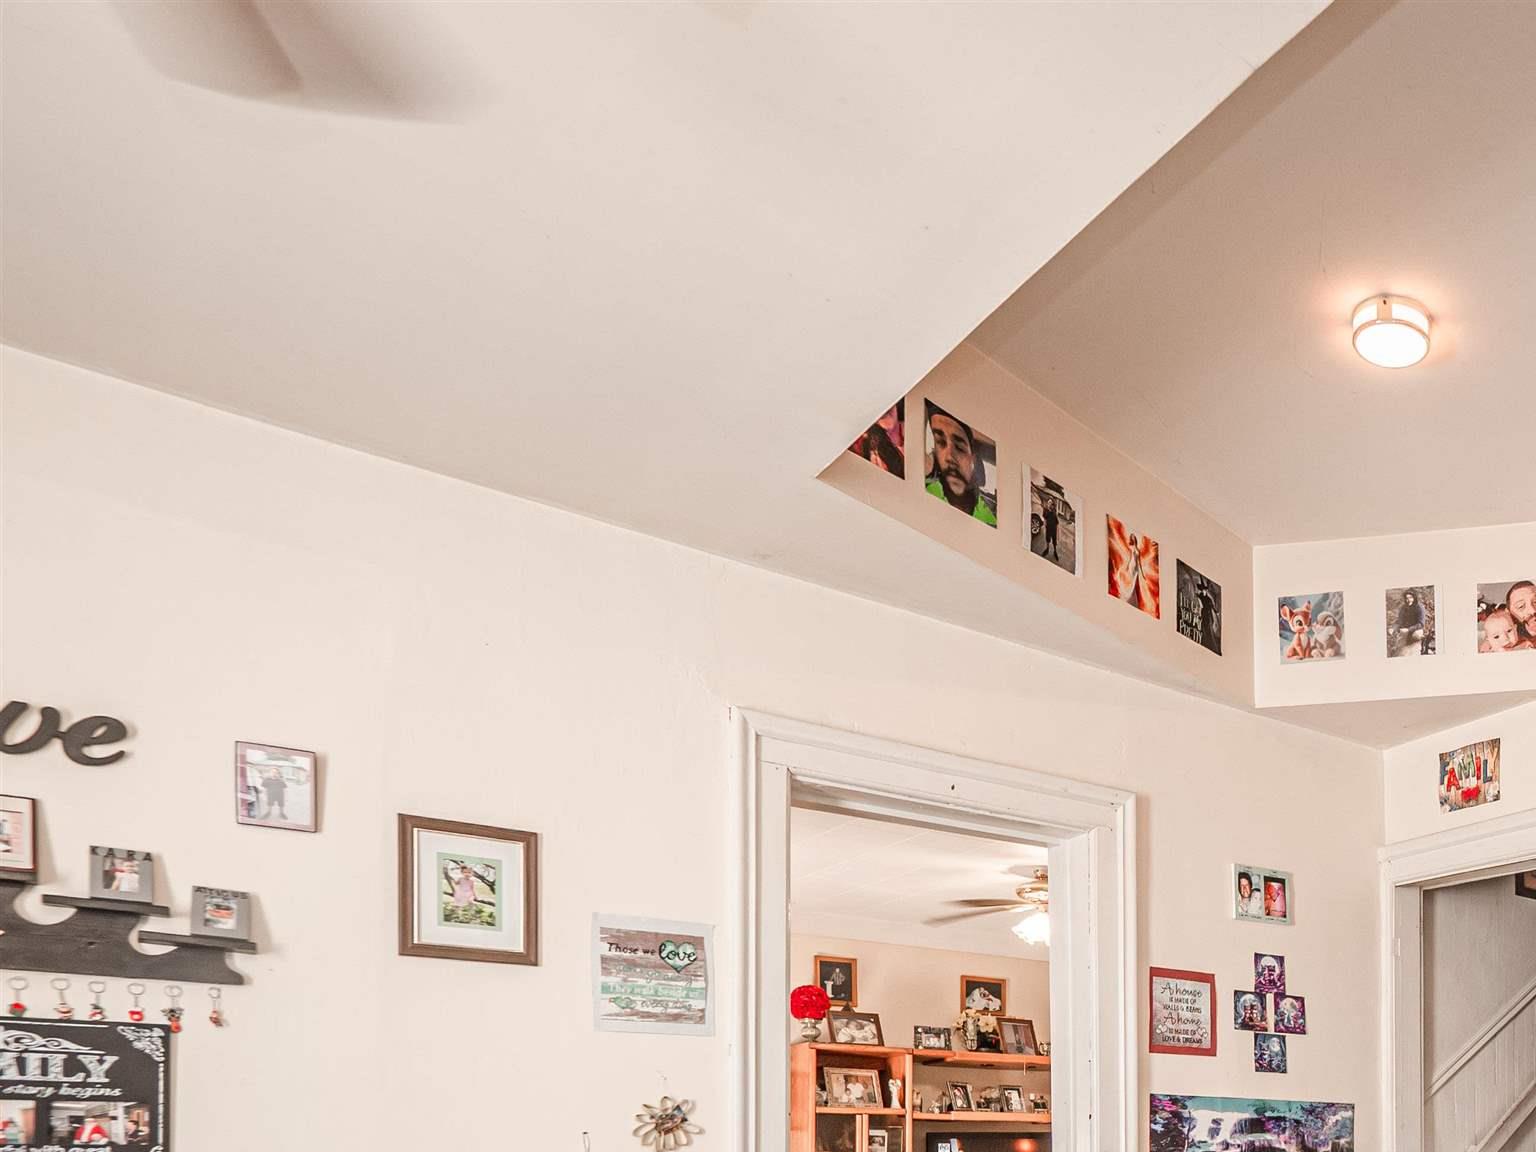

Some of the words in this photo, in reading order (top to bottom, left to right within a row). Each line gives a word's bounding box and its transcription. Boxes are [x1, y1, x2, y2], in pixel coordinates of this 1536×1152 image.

[1440, 744, 1499, 792] FAMILY
[91, 846, 152, 862] KARA
[607, 941, 639, 954] Those
[658, 942, 697, 962] love
[2, 1084, 56, 1098] story
[58, 1083, 123, 1099] begins
